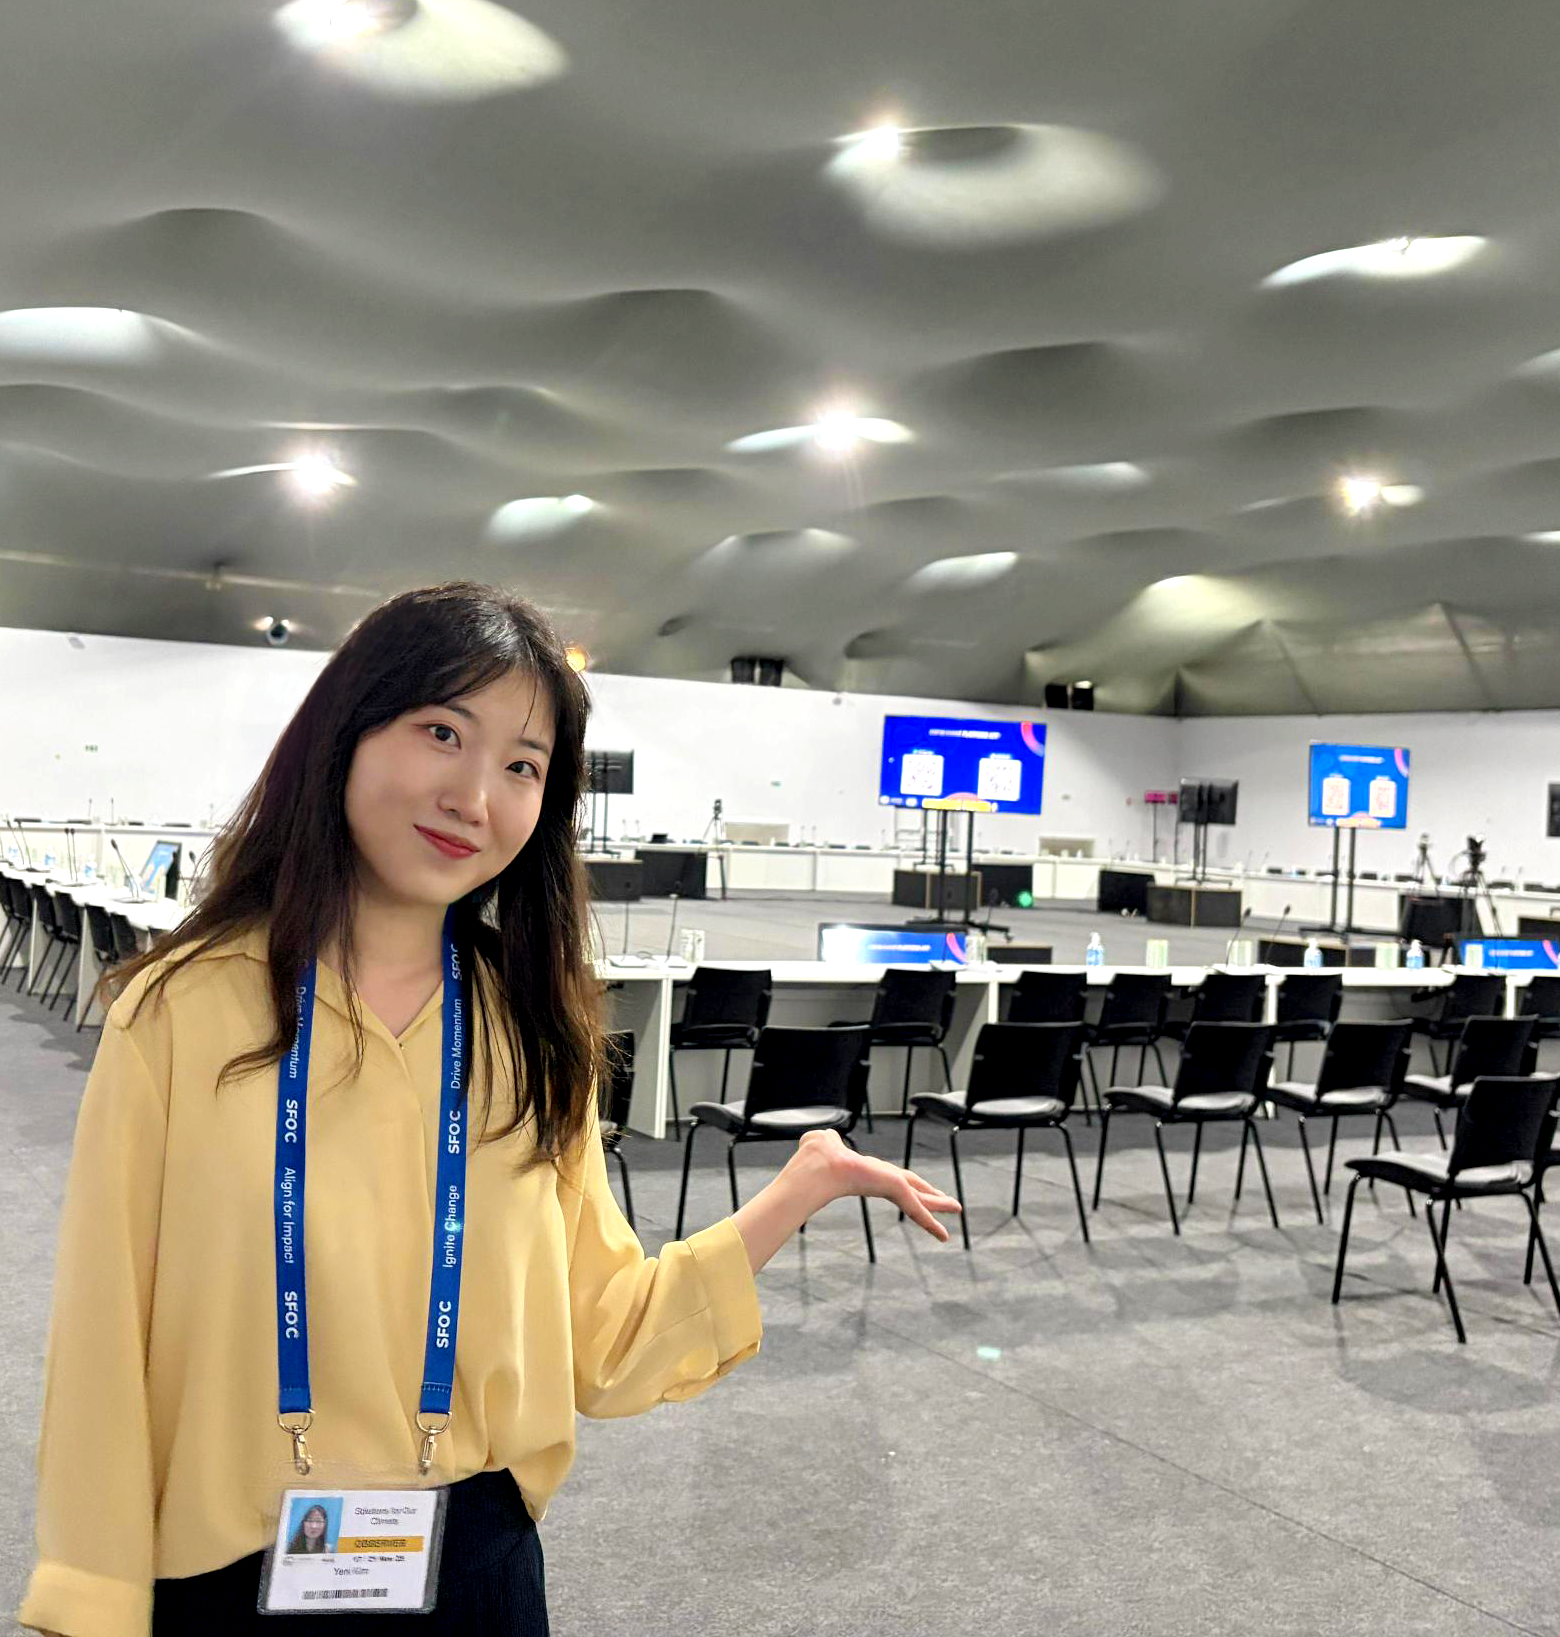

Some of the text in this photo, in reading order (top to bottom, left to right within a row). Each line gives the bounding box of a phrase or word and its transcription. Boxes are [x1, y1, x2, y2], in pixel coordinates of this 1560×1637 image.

[450, 998, 462, 1089] Drive Momentum
[280, 1166, 297, 1264] Align for Impact
[442, 1185, 460, 1268] Ignite Change
